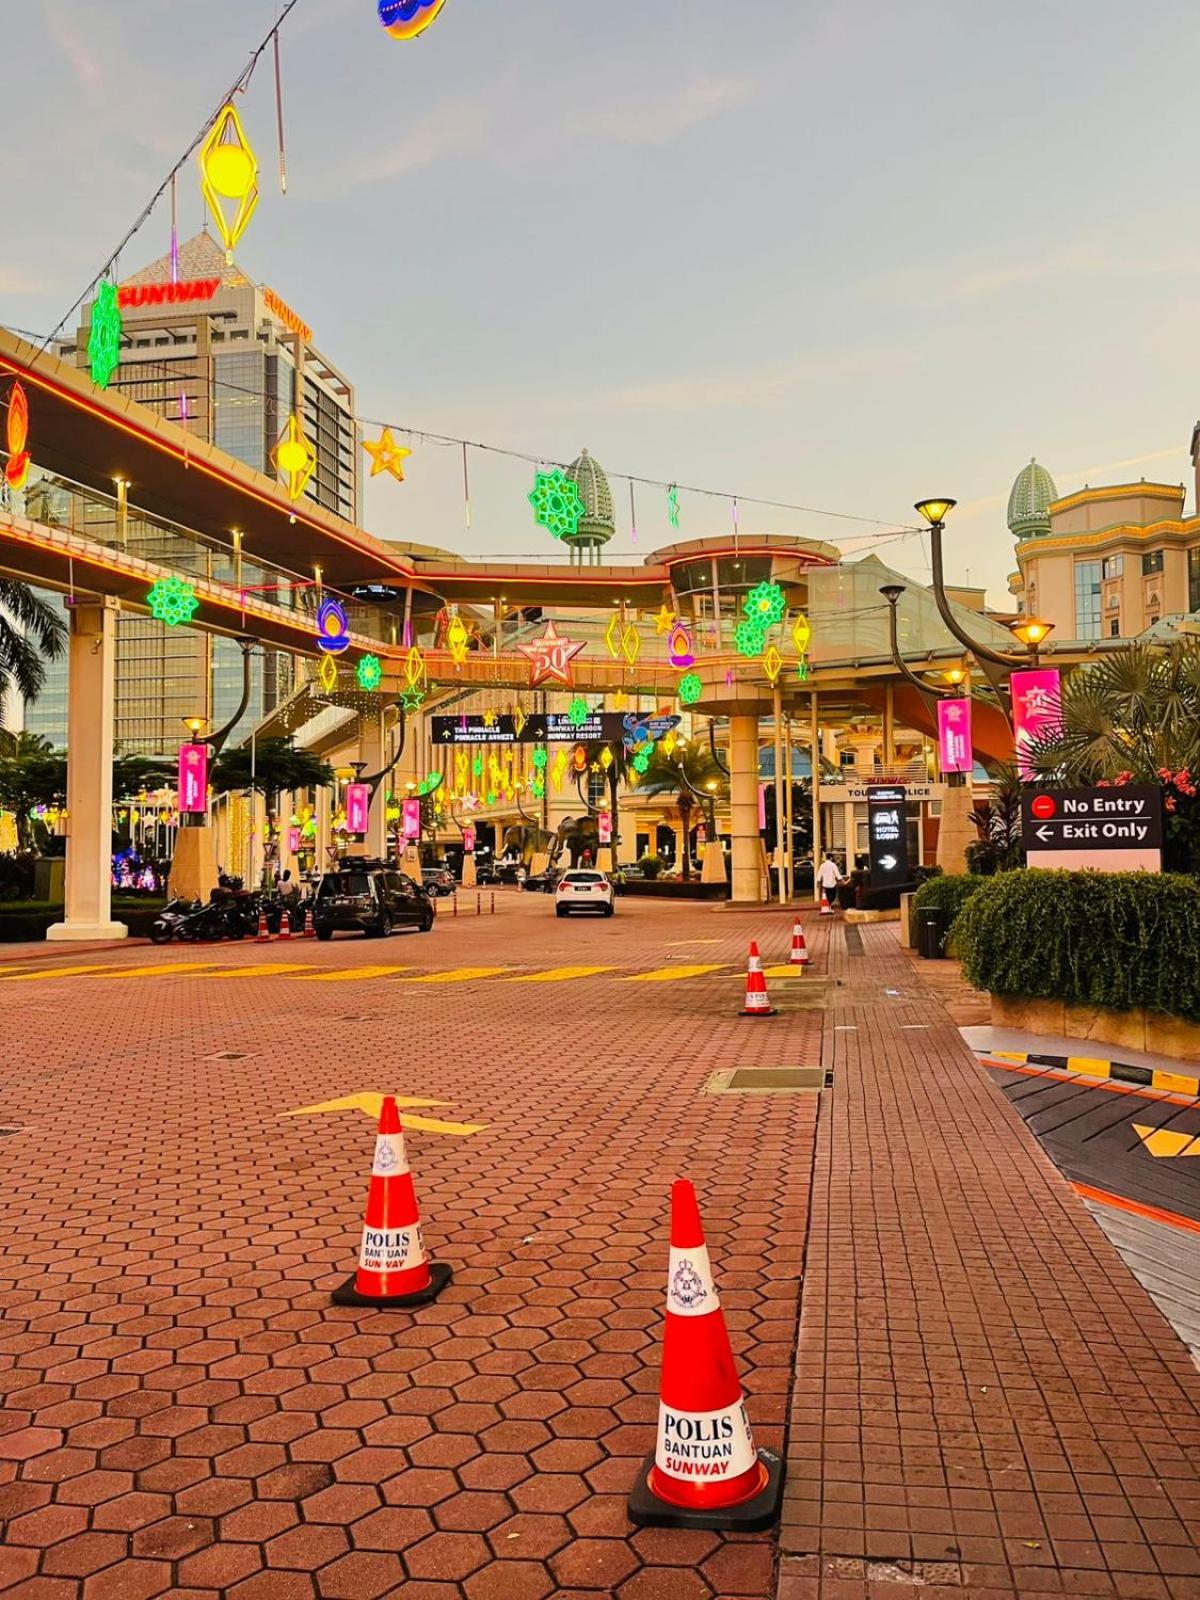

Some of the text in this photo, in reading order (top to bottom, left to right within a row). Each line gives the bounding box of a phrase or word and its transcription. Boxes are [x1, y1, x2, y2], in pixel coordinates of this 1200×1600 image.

[117, 277, 221, 309] SUNWAY
[263, 287, 312, 342] SUNWAY
[536, 646, 566, 670] 50
[547, 732, 575, 740] SUNWAY
[1063, 798, 1145, 814] No Entry
[1062, 822, 1148, 840] Exit Only
[365, 1231, 410, 1247] POLIS
[364, 1248, 408, 1258] BANUAN
[664, 1413, 733, 1441] POLIS
[664, 1438, 732, 1459] BANTUAN
[665, 1457, 730, 1476] SUNWAY
